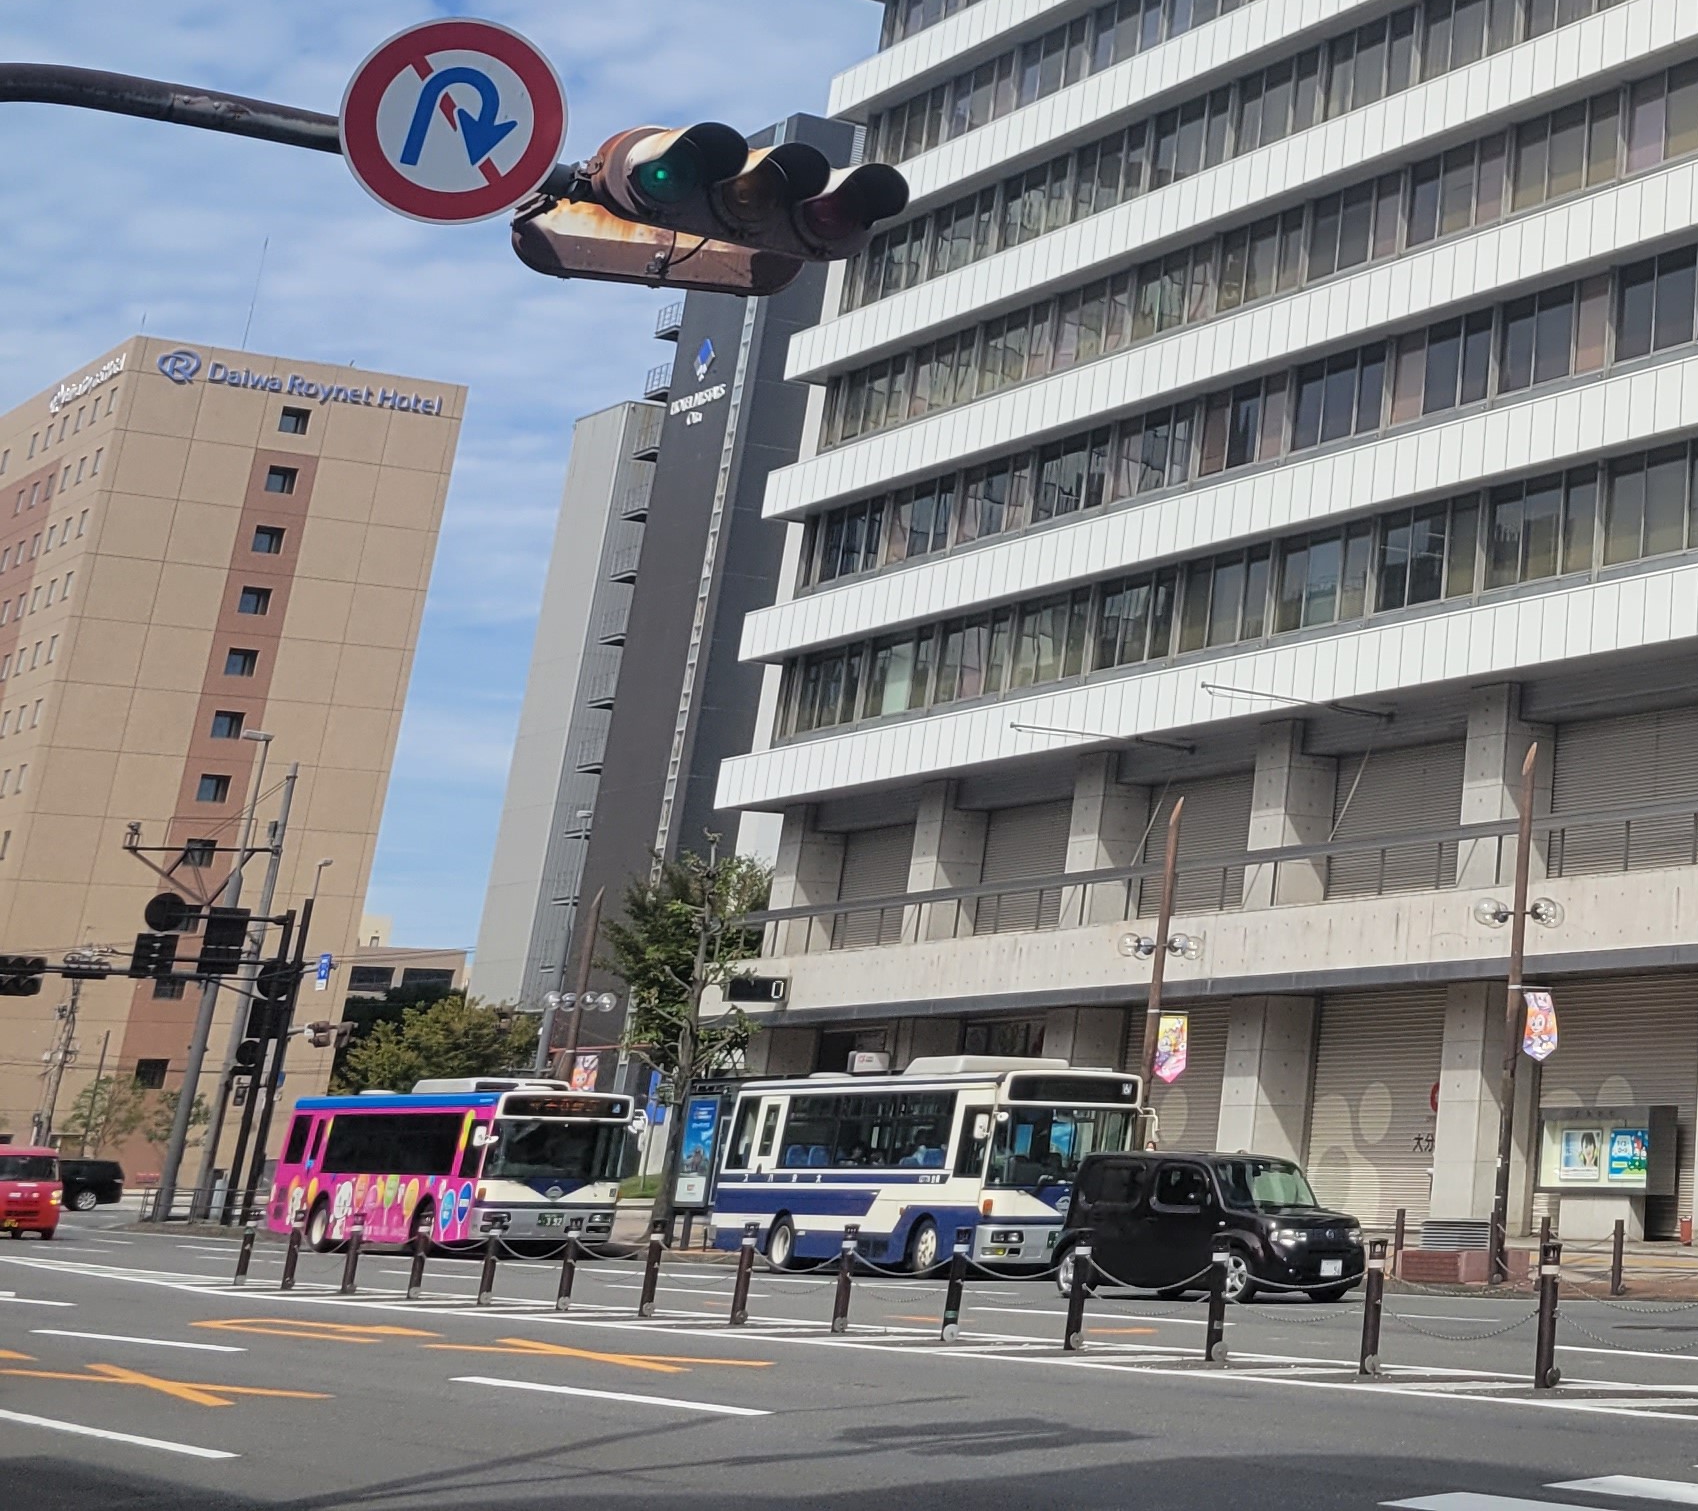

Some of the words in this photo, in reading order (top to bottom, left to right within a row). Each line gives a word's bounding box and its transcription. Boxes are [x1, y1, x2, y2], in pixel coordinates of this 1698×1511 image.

[207, 361, 282, 392] Daiwa
[287, 373, 373, 405] Roynet
[377, 386, 442, 416] Hotel
